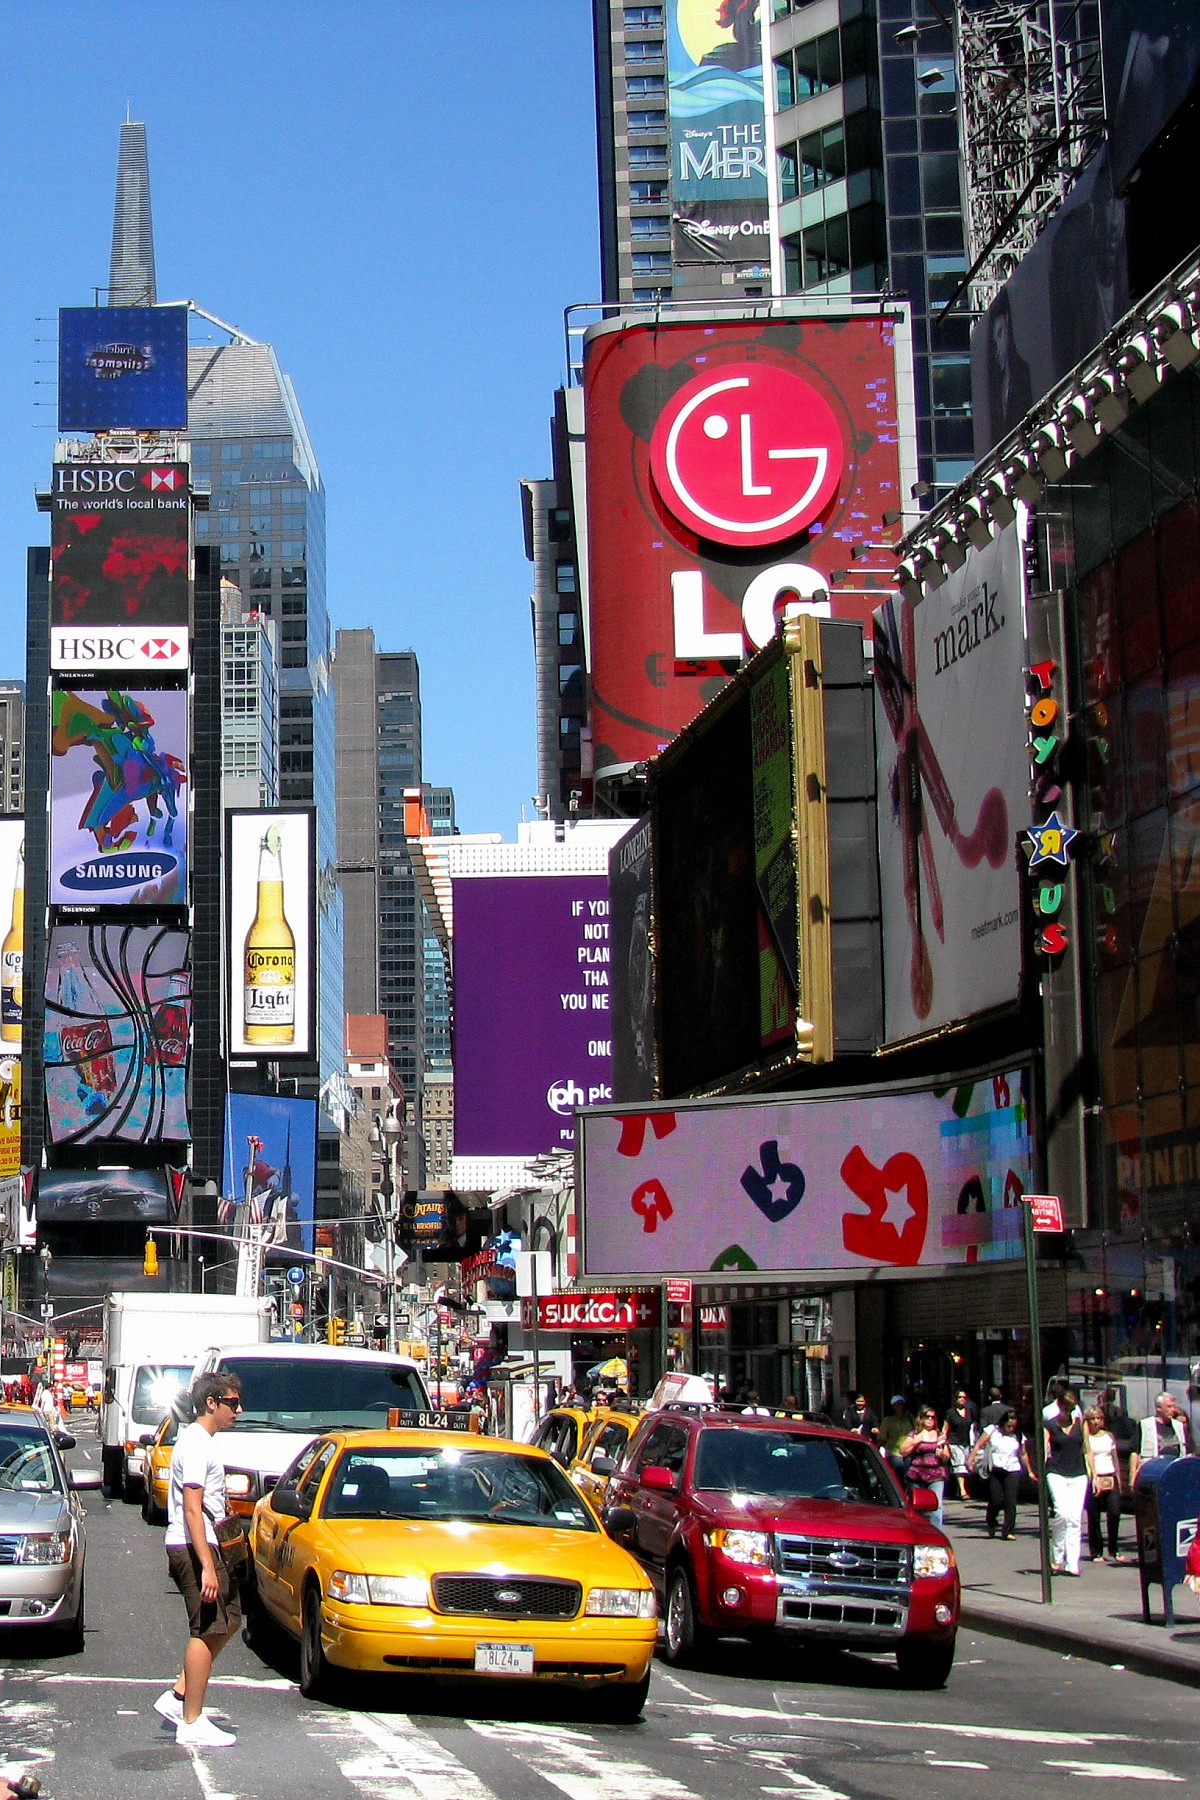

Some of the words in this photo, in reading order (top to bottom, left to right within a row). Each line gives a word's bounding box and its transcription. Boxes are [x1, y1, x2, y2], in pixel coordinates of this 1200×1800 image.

[717, 124, 762, 144] THE
[679, 140, 768, 181] MER
[57, 469, 136, 493] HSBC
[57, 499, 79, 509] The
[82, 498, 124, 509] world's
[126, 499, 154, 509] local
[157, 499, 187, 509] bank
[671, 563, 832, 661] LG
[933, 581, 1006, 677] mark.
[58, 638, 136, 660] HSBC
[75, 864, 163, 878] SAMSUNG
[571, 901, 584, 917] IF
[584, 923, 610, 940] NOT
[247, 951, 293, 970] Corona
[250, 988, 290, 1010] Light
[560, 994, 587, 1010] YOU
[545, 1299, 632, 1323] swatch
[418, 1412, 449, 1428] 8L24
[453, 1422, 467, 1430] DUTY
